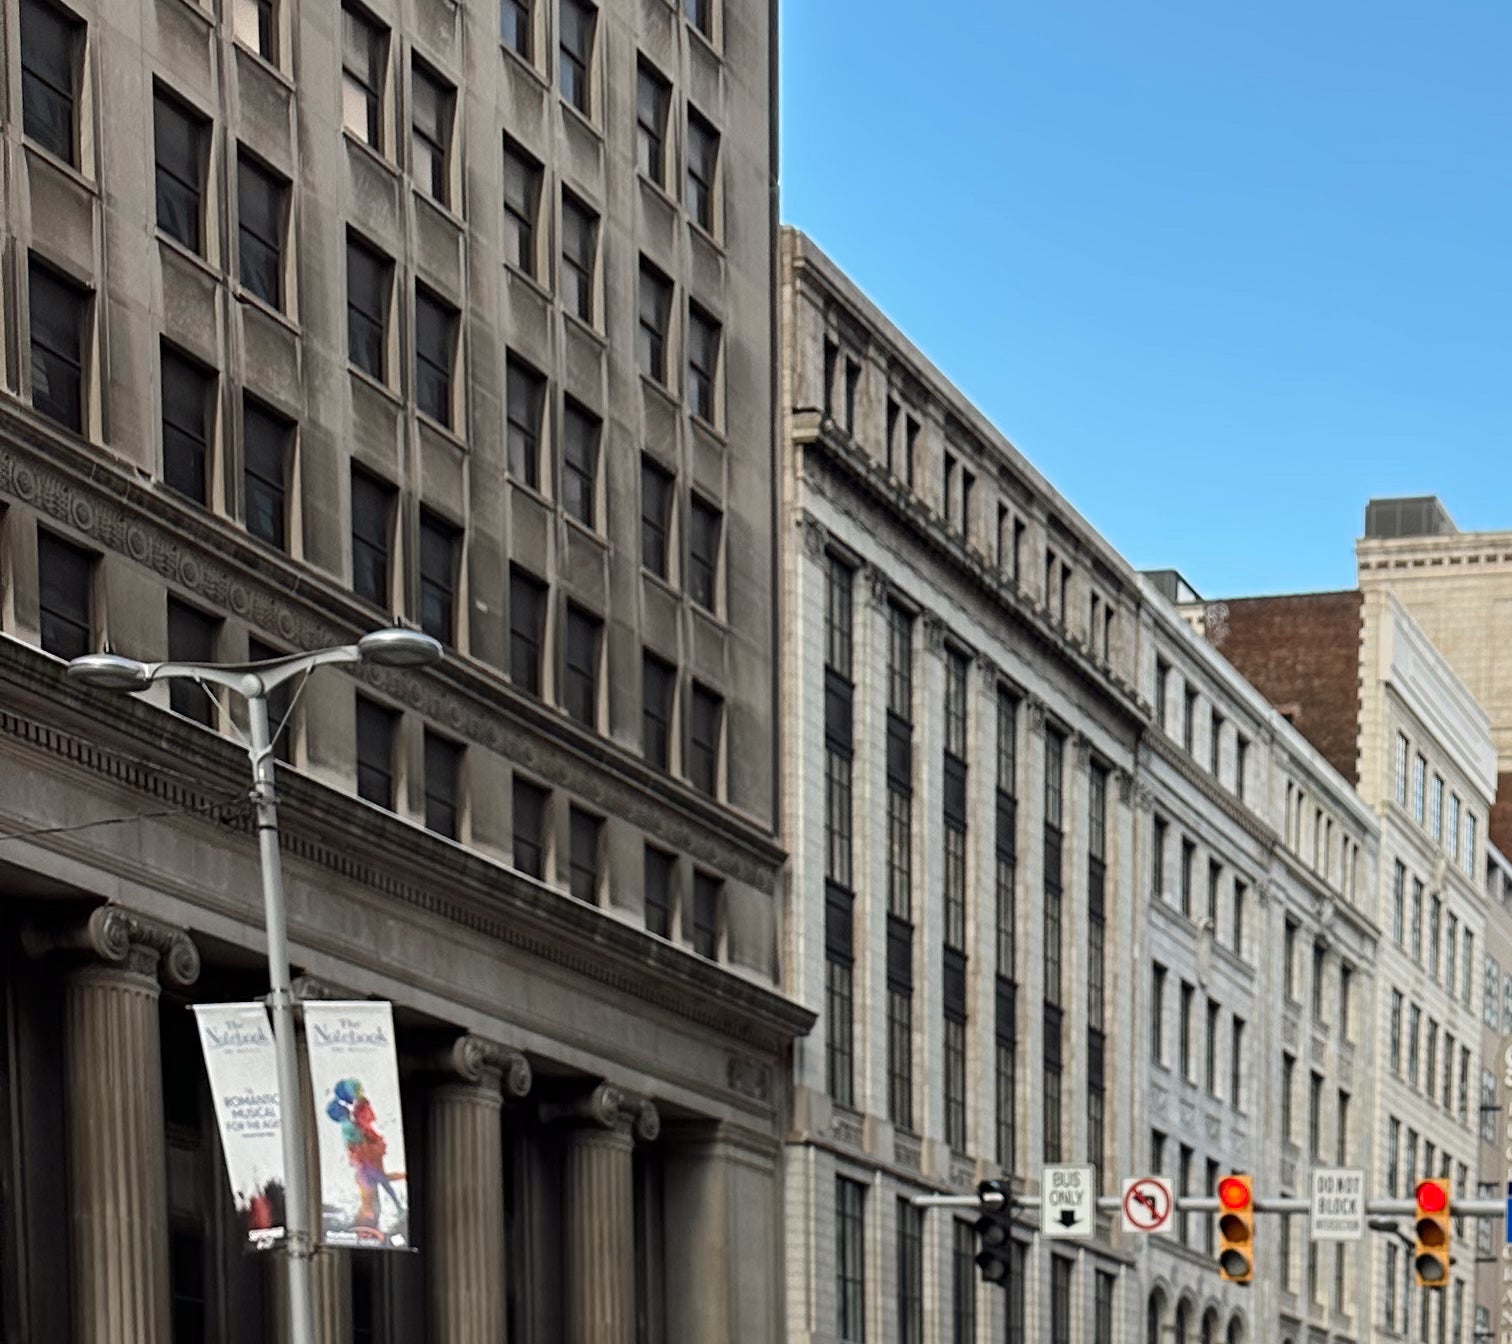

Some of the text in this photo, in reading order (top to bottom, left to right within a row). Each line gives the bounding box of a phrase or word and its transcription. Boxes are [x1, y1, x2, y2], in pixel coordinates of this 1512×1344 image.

[1052, 1171, 1081, 1188] BUS
[1317, 1176, 1360, 1194] DO NOT
[1049, 1189, 1085, 1206] ONLY
[1318, 1197, 1358, 1215] BLOCK
